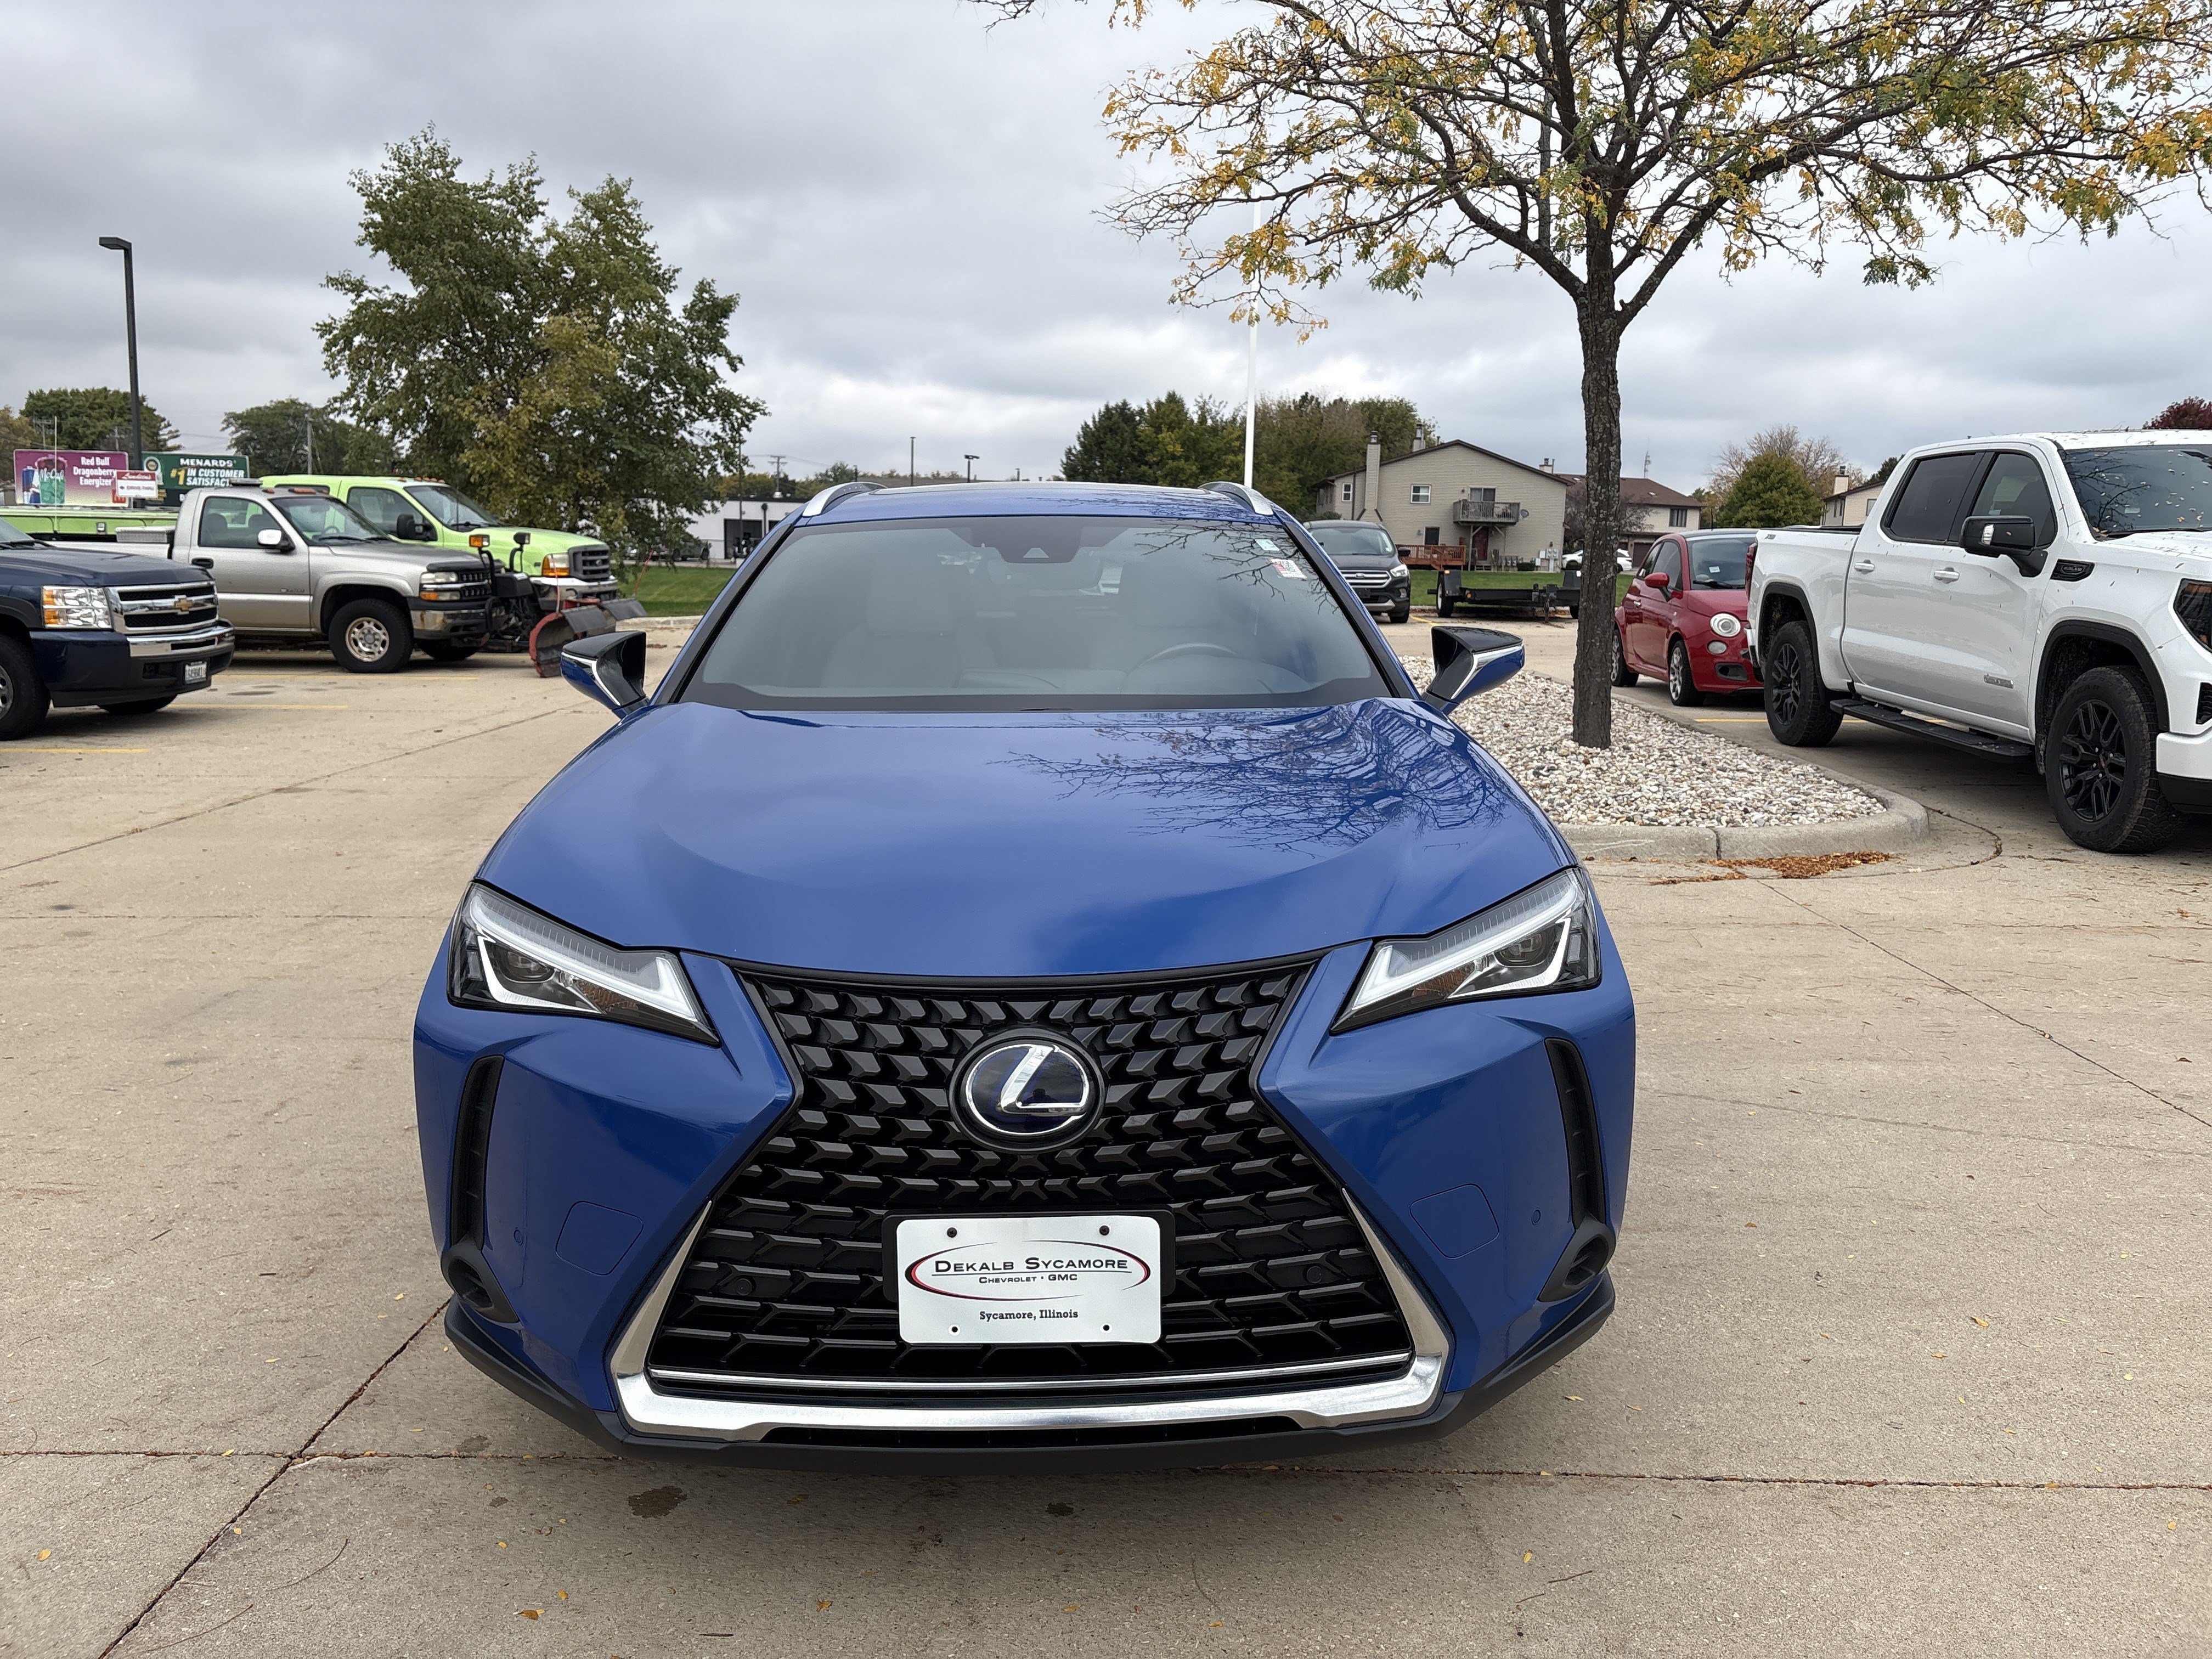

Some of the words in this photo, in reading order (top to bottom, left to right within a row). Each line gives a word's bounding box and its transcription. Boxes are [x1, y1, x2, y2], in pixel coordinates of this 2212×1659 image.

[81, 456, 95, 466] Red
[95, 456, 110, 466] Bull
[179, 458, 233, 468] MENARDS
[73, 466, 116, 478] Dragonberry
[170, 467, 186, 486] #1
[187, 467, 197, 476] IN
[198, 468, 245, 478] CUSTOMER
[80, 476, 112, 488] Energizer
[186, 476, 233, 487] SATISFACT
[934, 1260, 1015, 1273] DEKALB
[1024, 1257, 1128, 1270] SYCAMORE
[1047, 1273, 1078, 1282] GMC
[979, 1311, 1037, 1322] Sycamore,
[1039, 1308, 1079, 1319] Illinois
